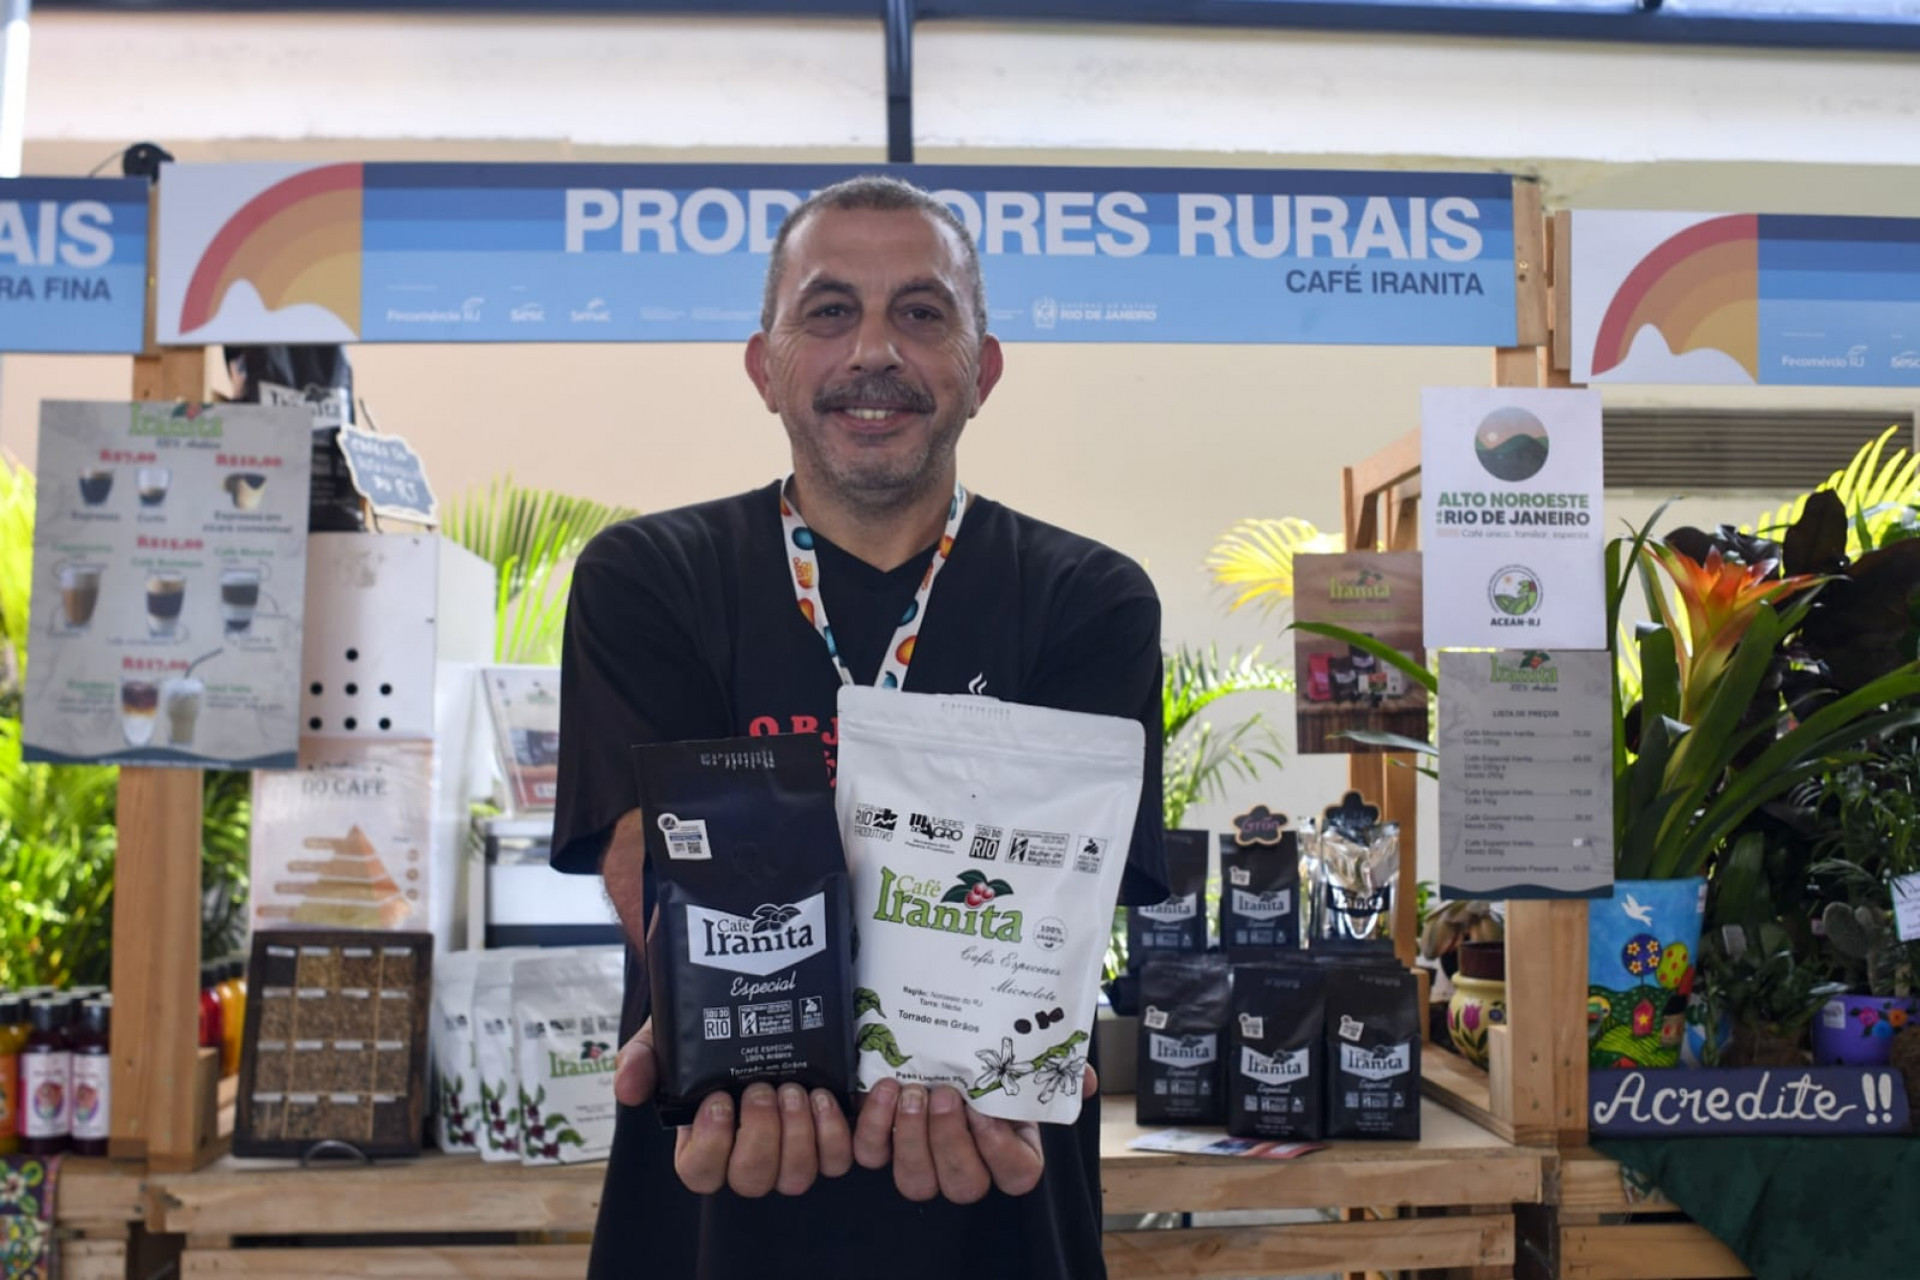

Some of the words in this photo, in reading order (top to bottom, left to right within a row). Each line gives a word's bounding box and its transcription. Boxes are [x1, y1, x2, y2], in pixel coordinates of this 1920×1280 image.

[564, 187, 1150, 257] PRODORES
[1178, 193, 1484, 262] RURAIS
[44, 276, 112, 301] FINA
[1286, 263, 1363, 295] CAFÉ
[1371, 271, 1485, 297] IRANITA
[1060, 310, 1083, 321] RIO
[1085, 310, 1100, 321] DE
[1105, 310, 1157, 321] JANEIRO
[1438, 492, 1486, 508] ALTO
[1490, 492, 1589, 509] NOROESTE
[1444, 510, 1478, 524] RIO
[1482, 511, 1506, 525] DE
[1509, 511, 1590, 526] JANEIRO
[1329, 576, 1390, 599] Iranita
[971, 838, 999, 859] RIO
[896, 873, 942, 898] Café
[874, 866, 1023, 943] Iranita
[1238, 895, 1285, 912] Iranita
[717, 918, 750, 933] Café
[703, 918, 815, 957] Iranita
[731, 971, 796, 1001] Especial
[706, 1020, 730, 1037] RIO
[899, 1009, 933, 1024] Torrado
[934, 1018, 948, 1027] em
[951, 1019, 979, 1033] Grãos
[1157, 1040, 1209, 1058] Iranita
[1349, 1050, 1402, 1069] Iranita
[1249, 1053, 1302, 1074] Iranita
[1593, 1071, 1857, 1124] Acredite
[1861, 1072, 1893, 1125] !!
